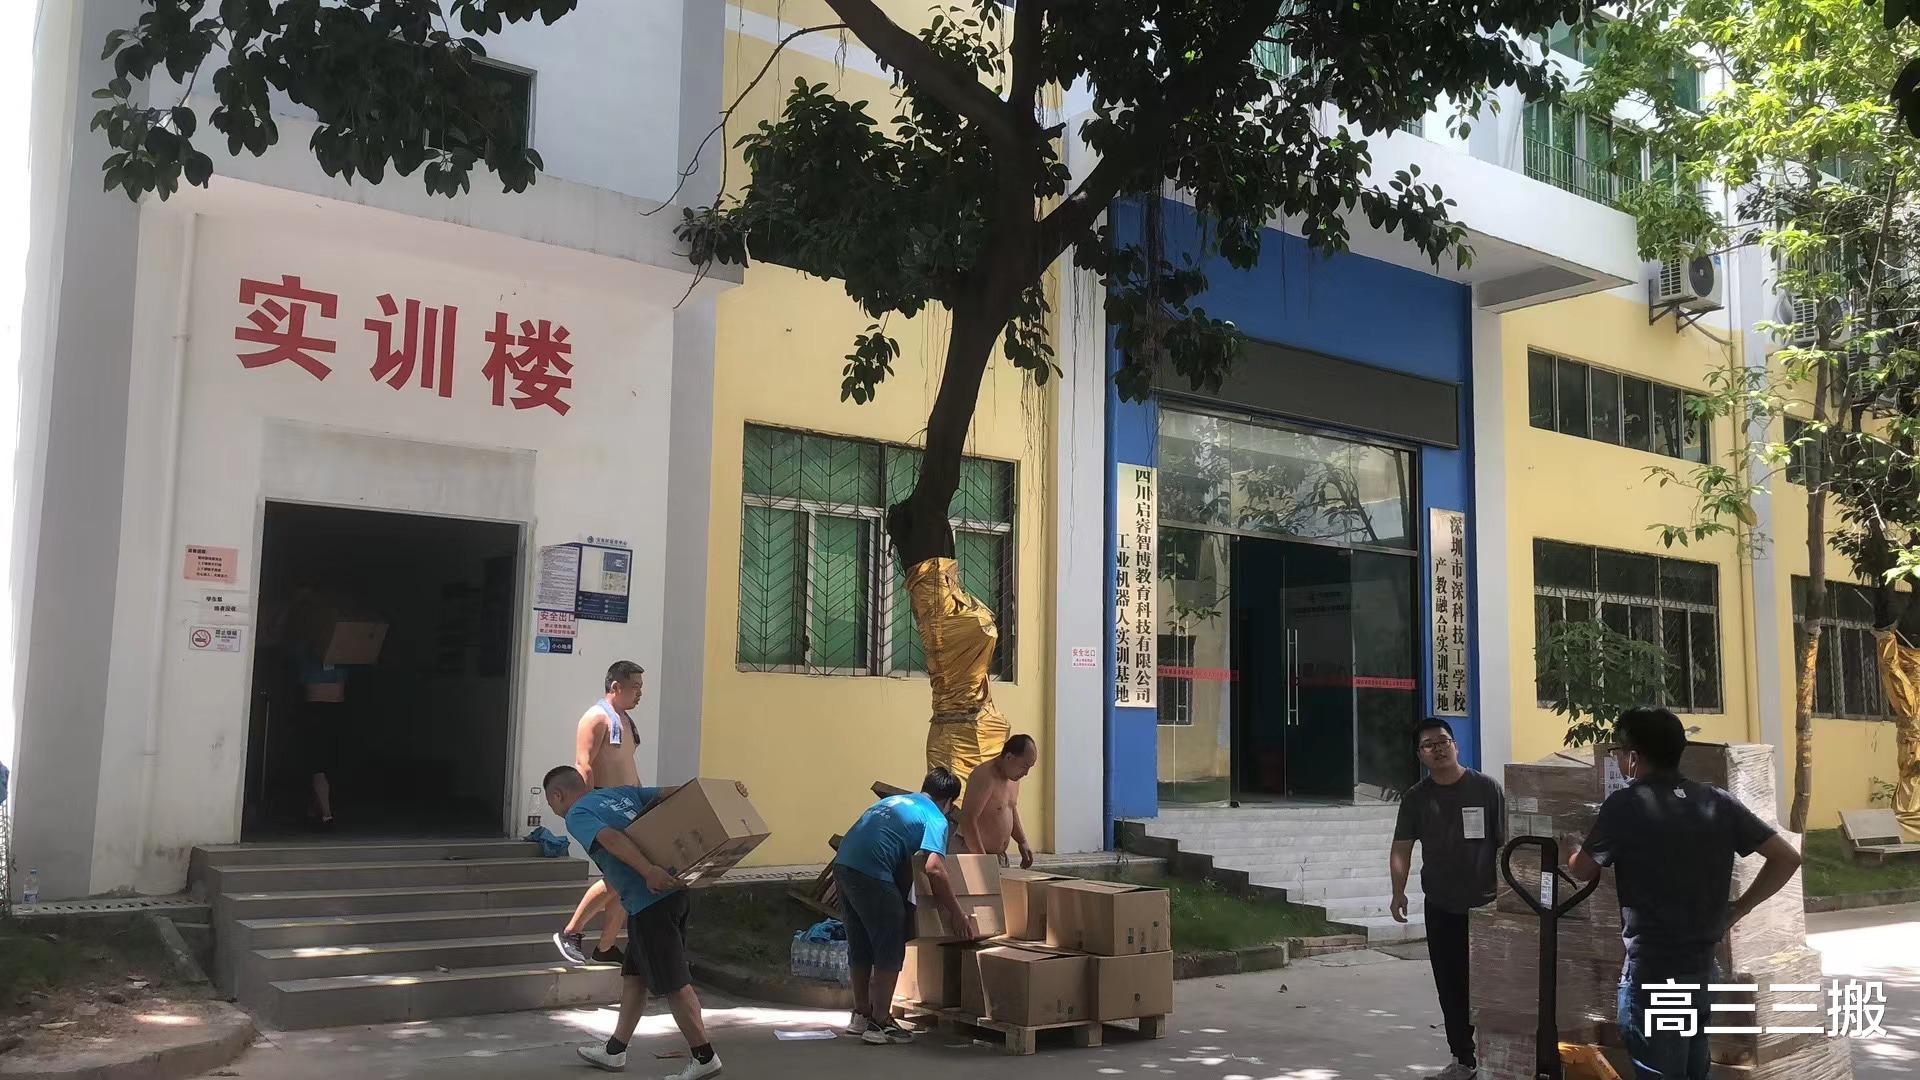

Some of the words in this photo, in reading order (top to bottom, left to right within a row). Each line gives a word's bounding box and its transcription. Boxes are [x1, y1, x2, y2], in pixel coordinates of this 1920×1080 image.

[235, 274, 574, 416] 实训楼
[540, 611, 576, 622] 安全出口
[1072, 648, 1096, 657] 安全出口
[1115, 533, 1130, 703] 工业机器人实训基地
[1435, 557, 1449, 711] 产教融合实训基地
[1450, 515, 1466, 712] 深圳市深科技工学校
